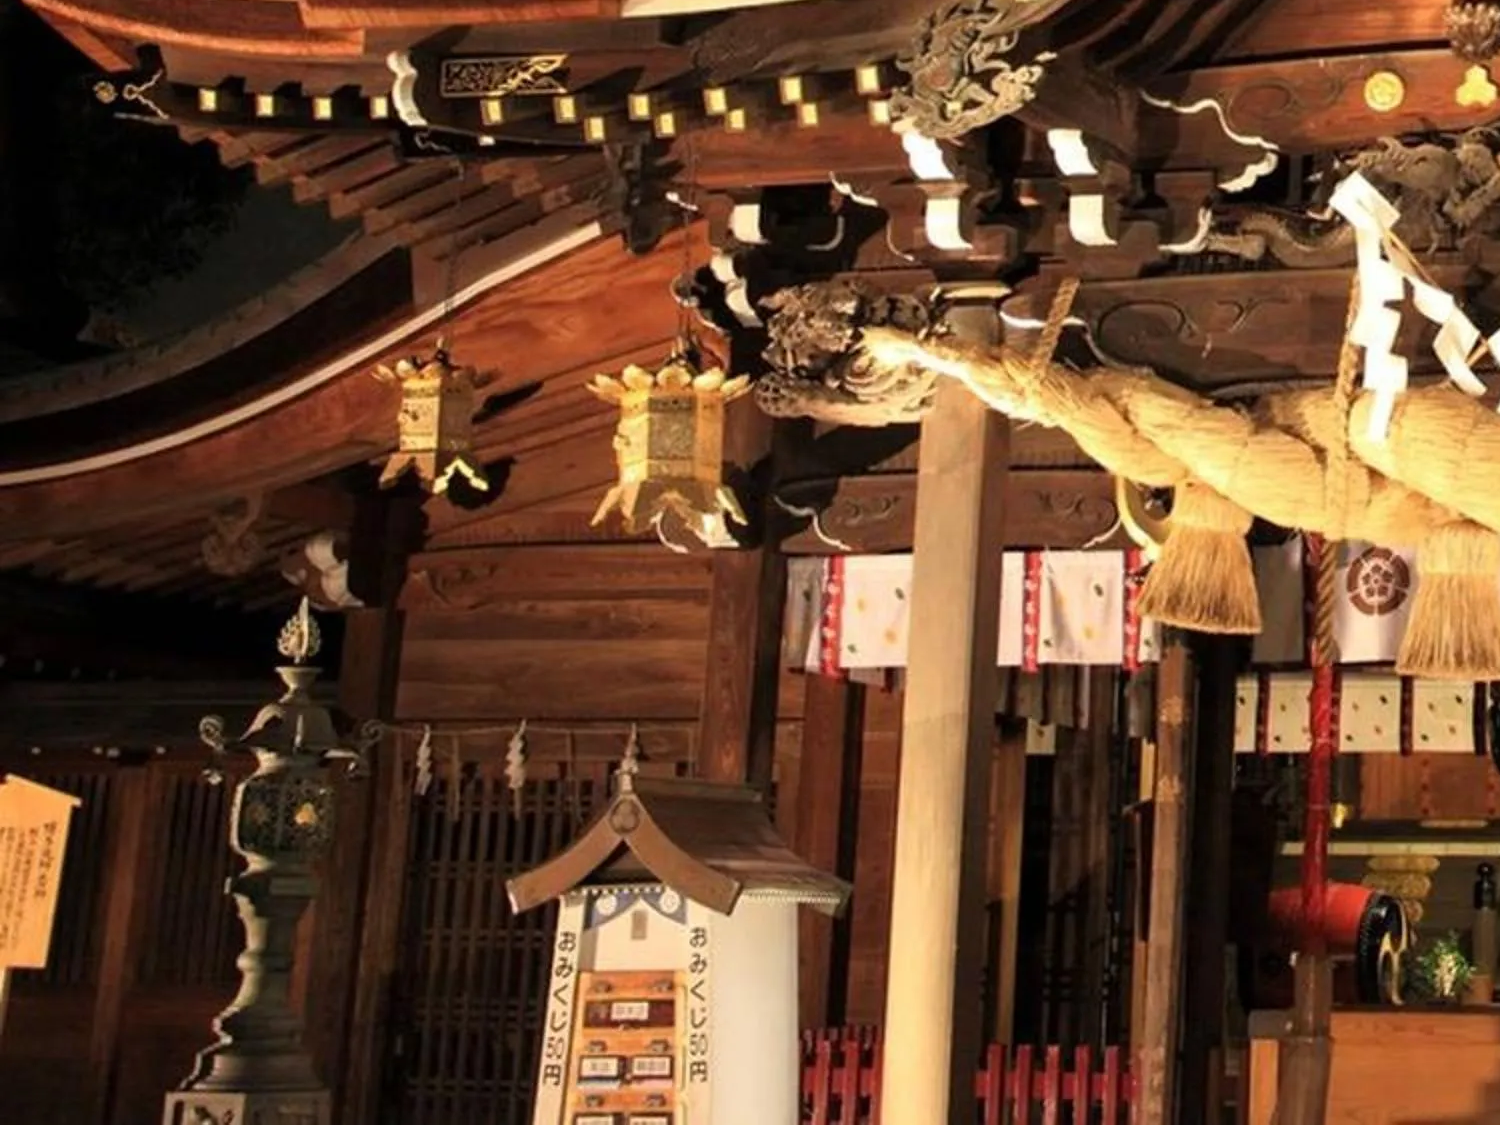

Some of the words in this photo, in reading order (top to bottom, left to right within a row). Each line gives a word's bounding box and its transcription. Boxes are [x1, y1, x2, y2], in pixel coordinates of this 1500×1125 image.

[543, 931, 576, 1086] おみくじ50円
